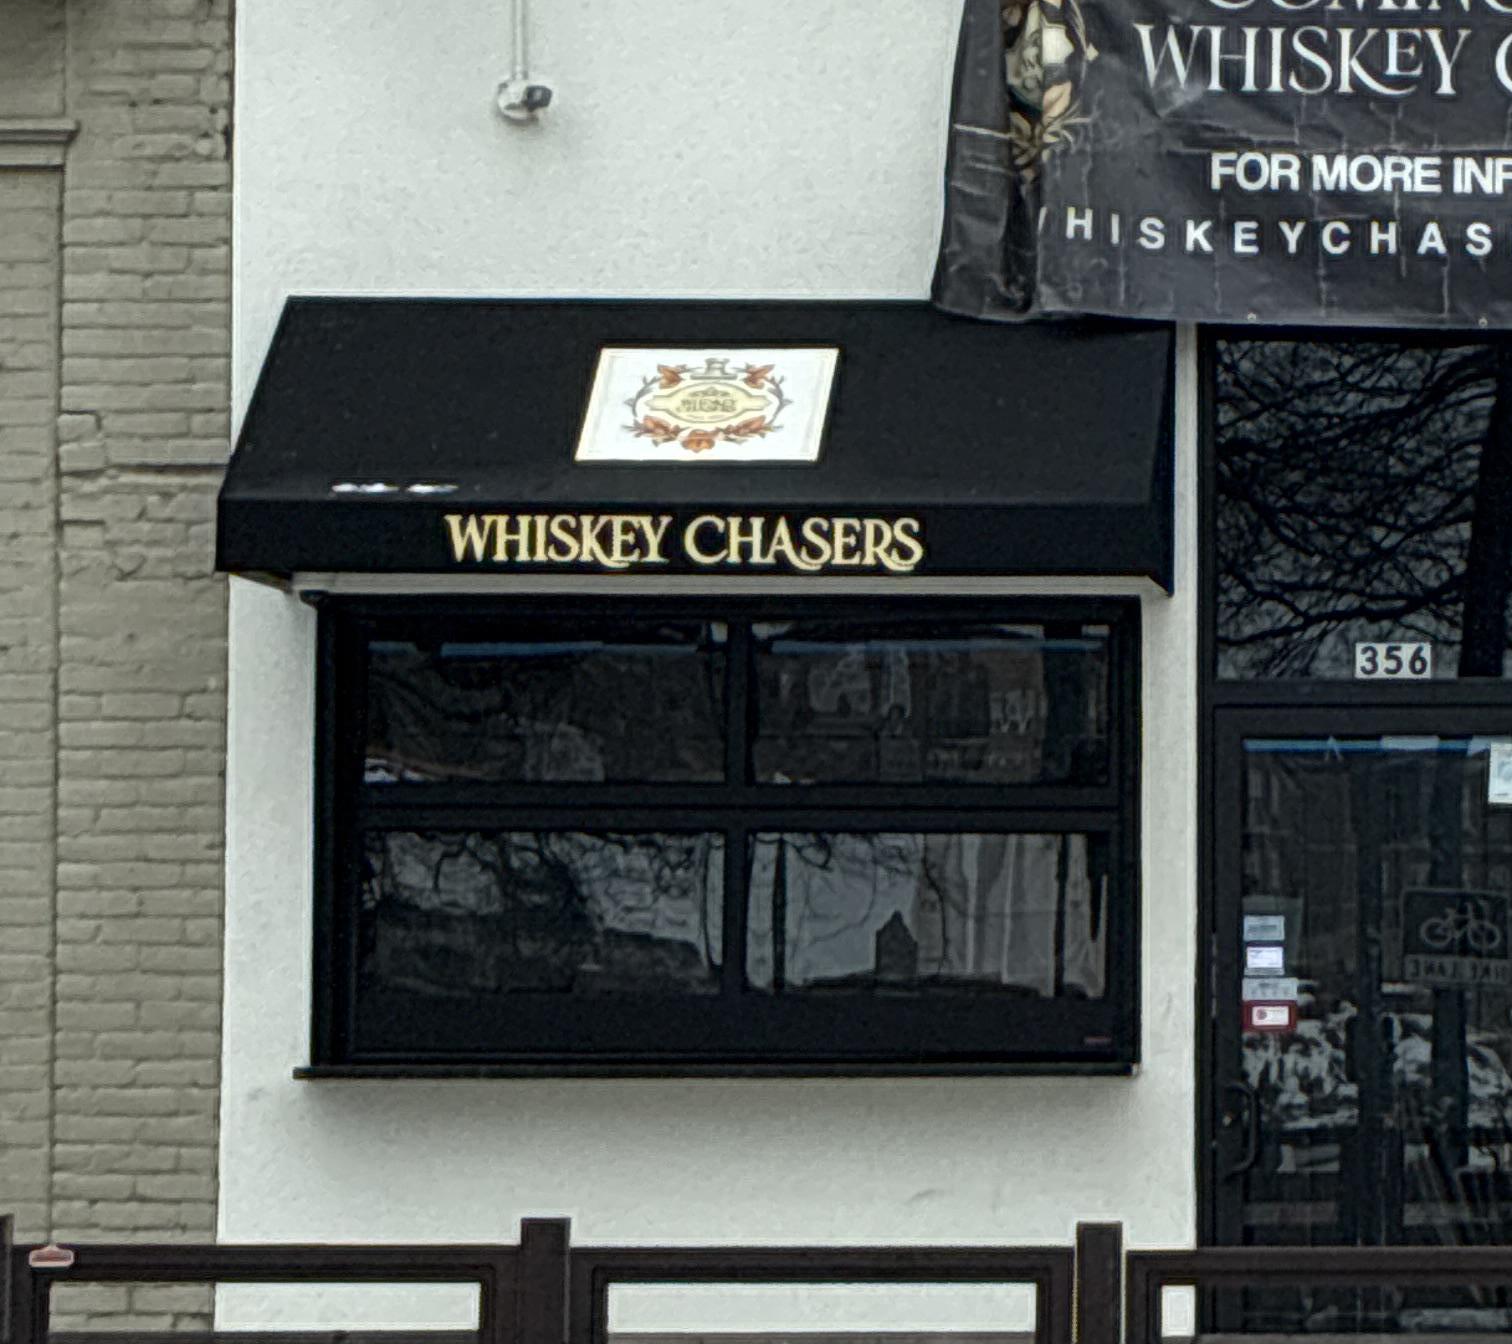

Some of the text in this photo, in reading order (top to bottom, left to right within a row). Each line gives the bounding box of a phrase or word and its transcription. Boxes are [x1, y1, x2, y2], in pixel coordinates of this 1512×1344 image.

[1133, 23, 1471, 96] WHISKEY
[1211, 151, 1301, 191] FOR
[1311, 153, 1442, 193] MORE
[444, 514, 923, 572] WHISKEY CHASERS
[1360, 645, 1428, 676] 356
